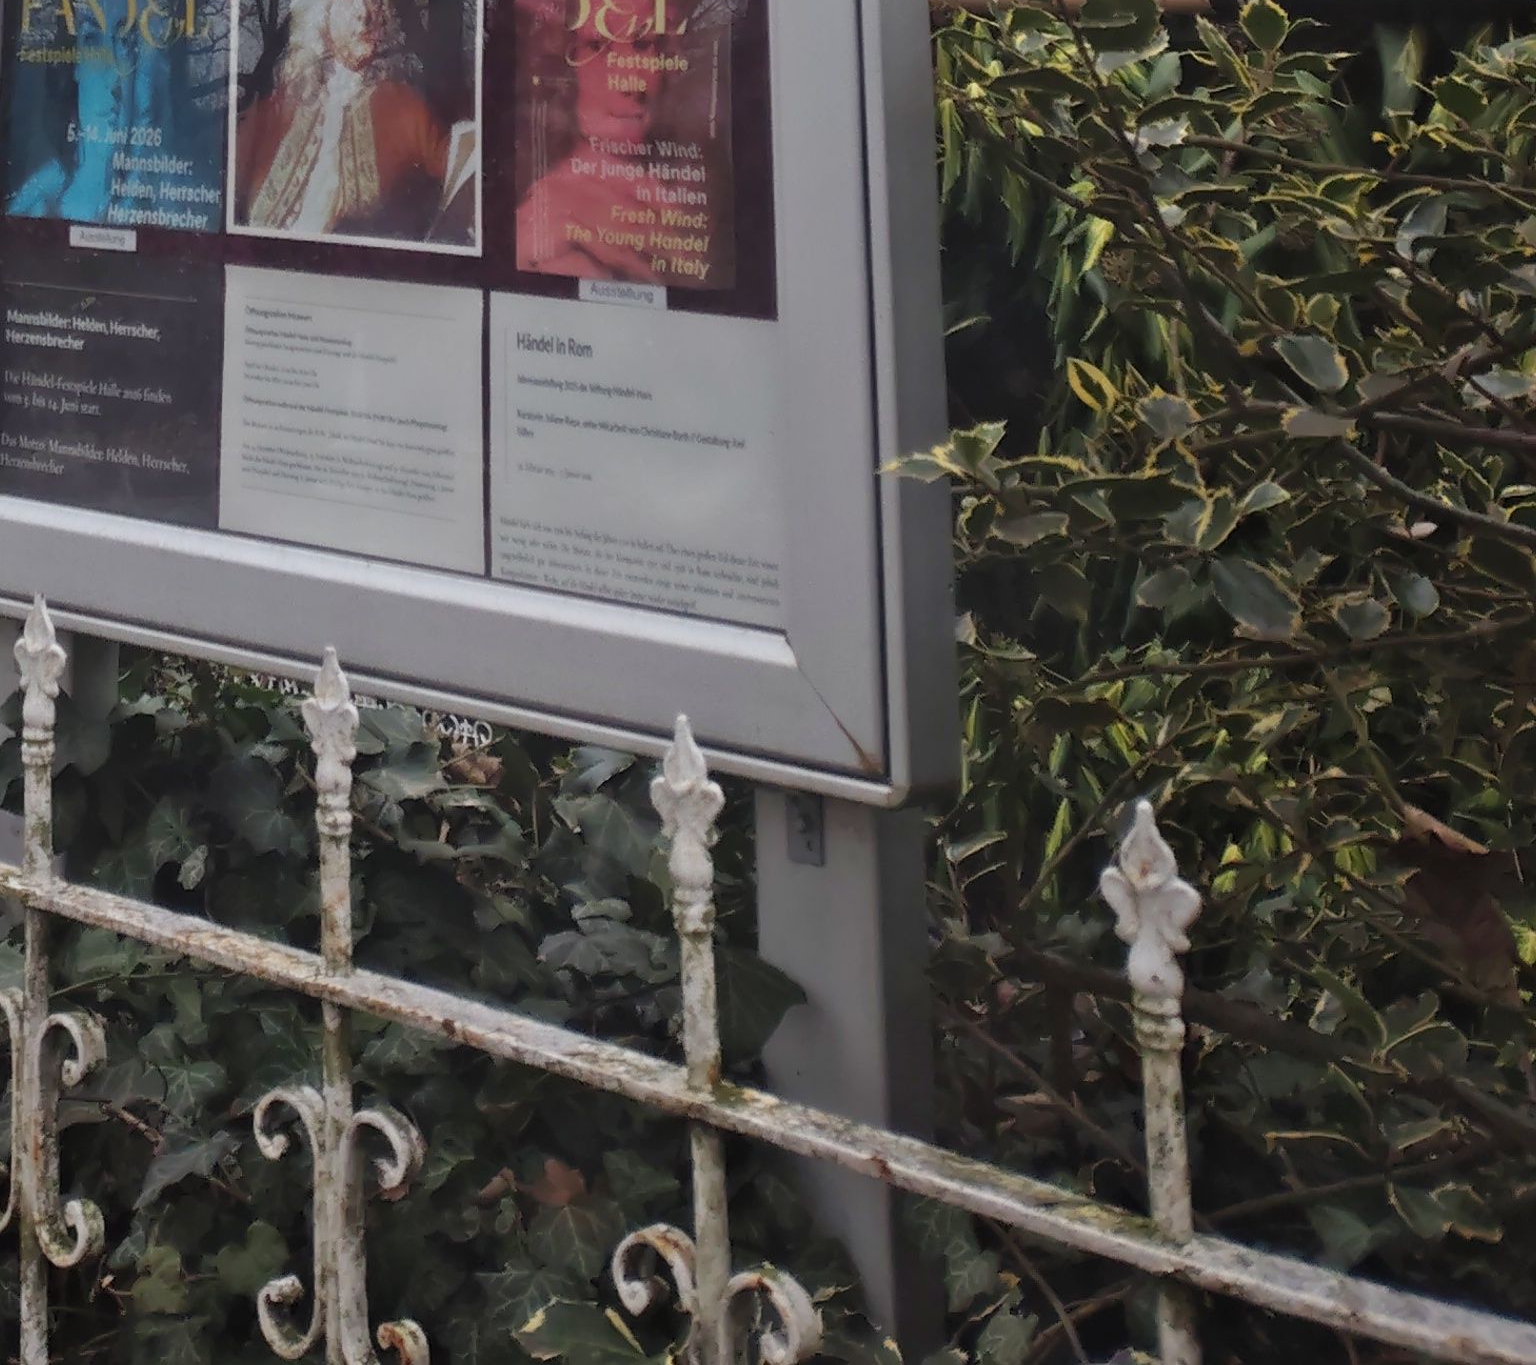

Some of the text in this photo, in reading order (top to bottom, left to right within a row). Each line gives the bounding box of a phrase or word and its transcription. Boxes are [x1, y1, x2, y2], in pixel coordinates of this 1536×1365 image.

[607, 52, 689, 73] Festspiele
[607, 73, 647, 92] Halle
[130, 127, 162, 147] 2026
[588, 136, 704, 160] Frischer Wind:
[570, 157, 706, 183] Der junge Händel
[636, 185, 708, 206] in Italien
[611, 205, 709, 230] Fresh Wind:
[565, 224, 592, 243] The
[596, 226, 645, 251] Young
[650, 254, 711, 281] in Italy
[516, 331, 594, 359] Händel in Rom
